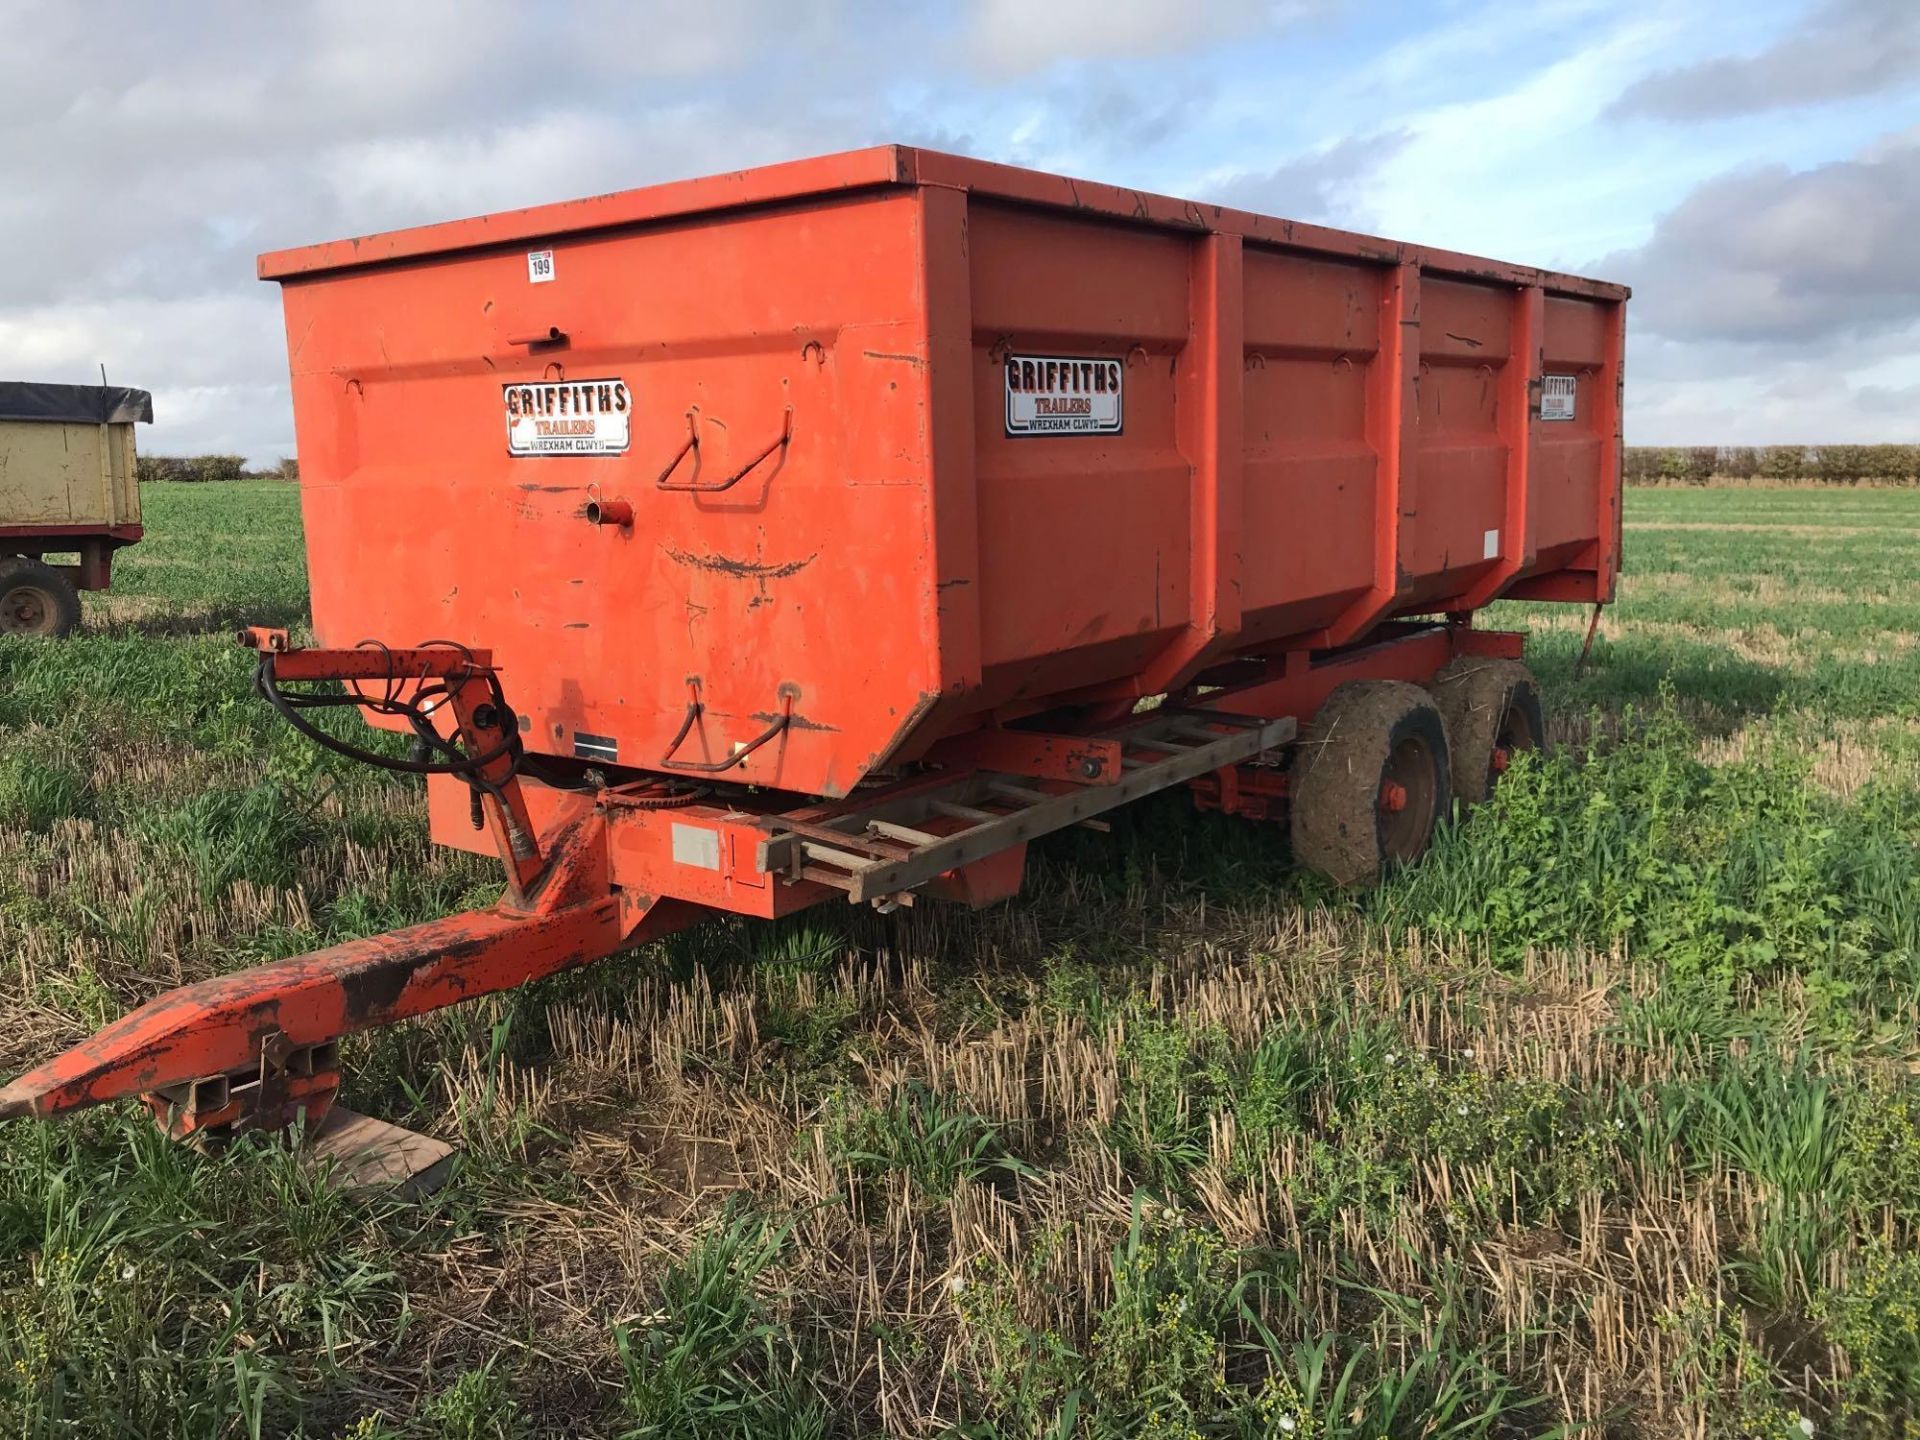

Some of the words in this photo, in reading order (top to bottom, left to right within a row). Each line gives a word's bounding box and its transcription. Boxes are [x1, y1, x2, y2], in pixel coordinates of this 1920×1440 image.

[533, 259, 550, 275] 199
[1008, 359, 1120, 394] GRIFFITHS
[507, 383, 627, 416] GRIFFITHS
[1034, 398, 1091, 414] TRAILERS
[535, 420, 595, 435] TRAILERS
[1029, 419, 1071, 430] WREXHAM
[1073, 419, 1098, 430] CLWYD
[530, 440, 573, 451] WREXHAM
